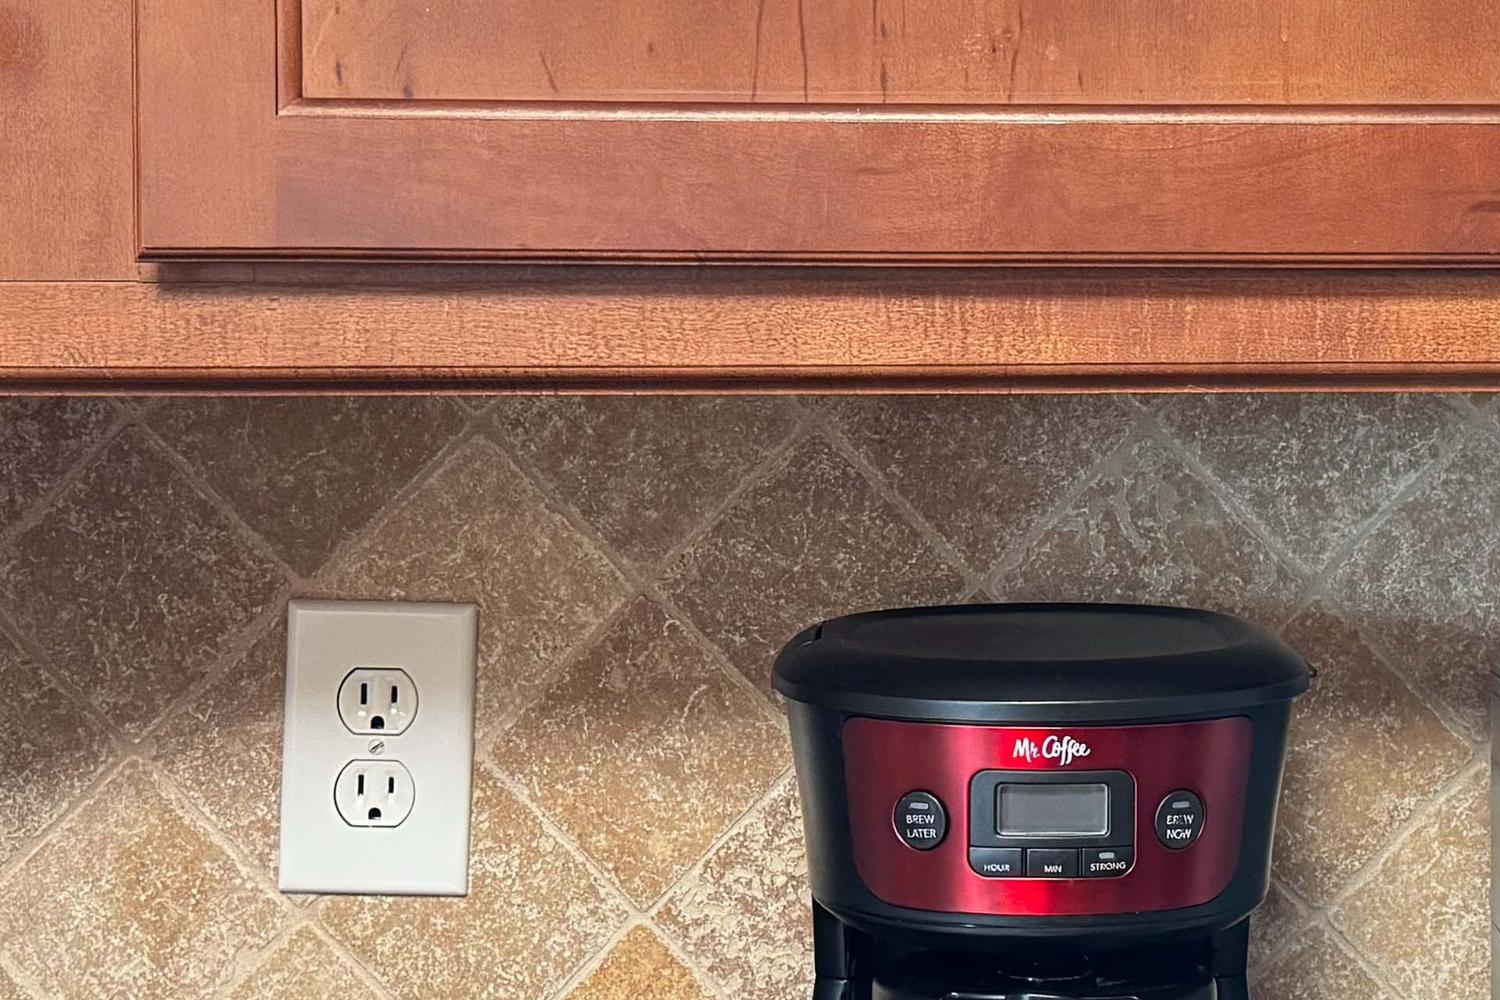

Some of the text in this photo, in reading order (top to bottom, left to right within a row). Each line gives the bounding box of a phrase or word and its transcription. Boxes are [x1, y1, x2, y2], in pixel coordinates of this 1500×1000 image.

[1012, 735, 1091, 766] Mr. Coffee
[906, 814, 935, 824] BREW
[906, 828, 937, 838] LATER
[1166, 828, 1192, 839] NOW
[984, 863, 1010, 872] HOUR
[1044, 864, 1062, 873] MIN
[1089, 861, 1126, 872] STRONG
